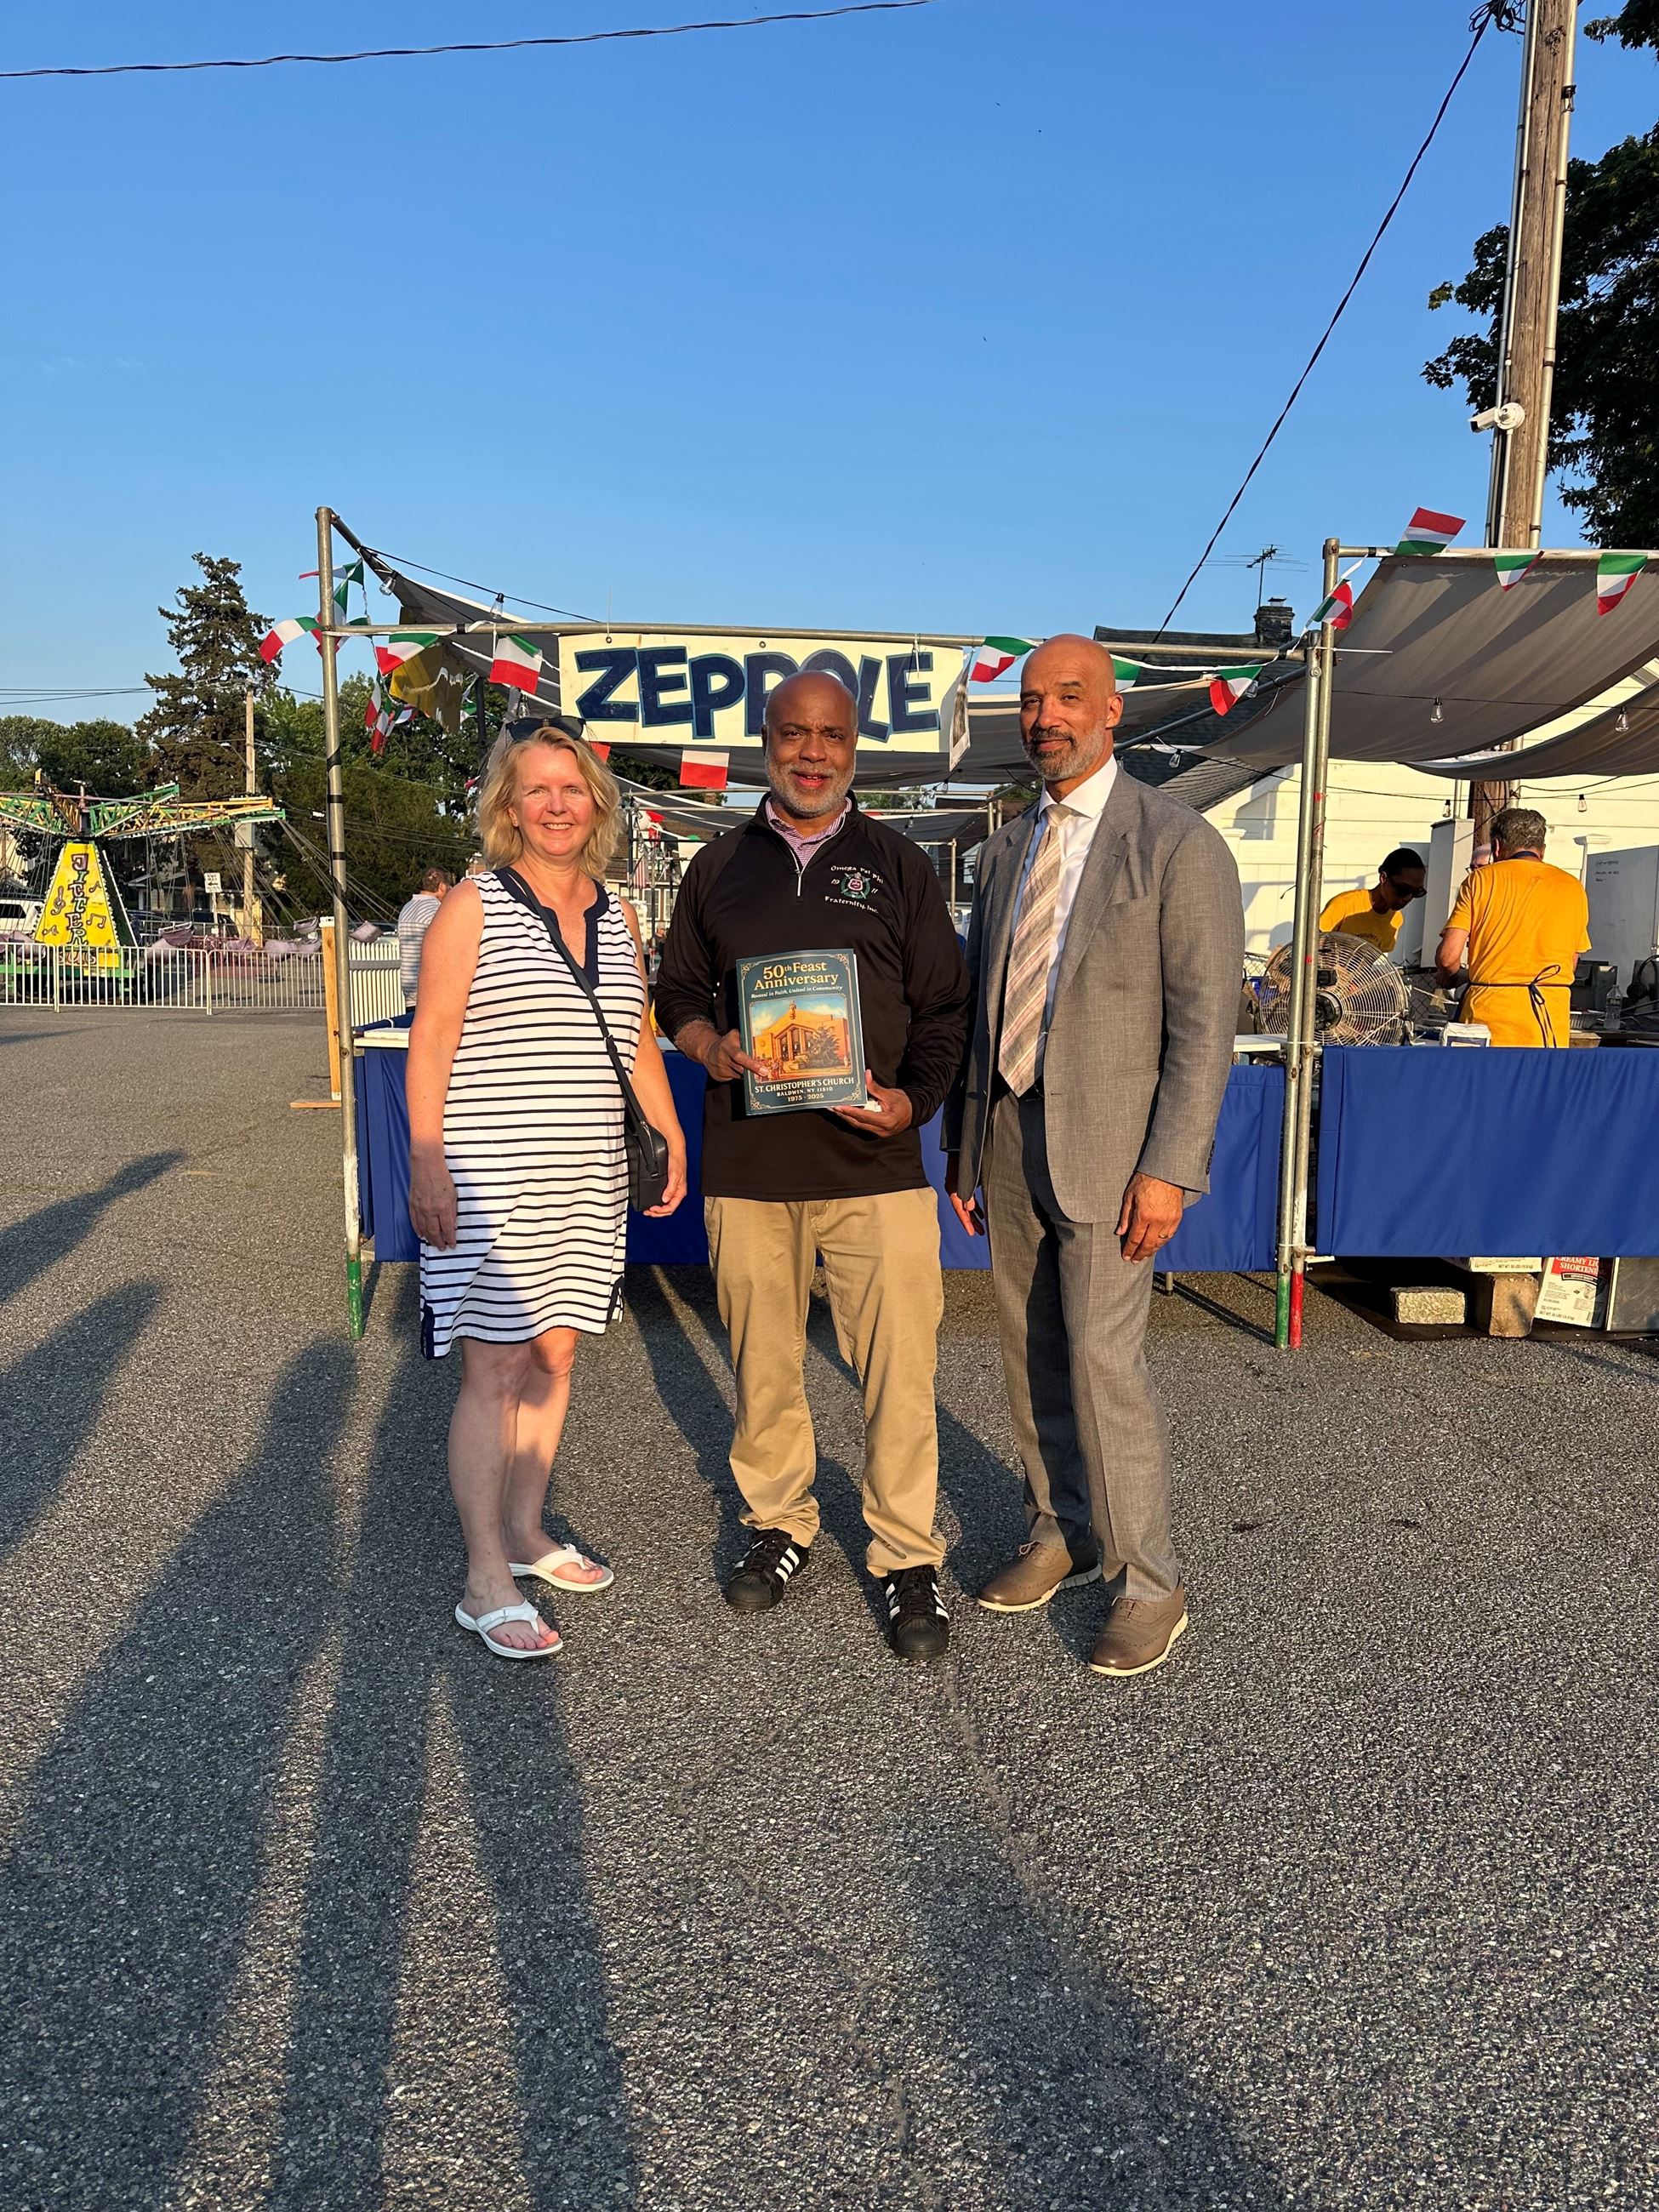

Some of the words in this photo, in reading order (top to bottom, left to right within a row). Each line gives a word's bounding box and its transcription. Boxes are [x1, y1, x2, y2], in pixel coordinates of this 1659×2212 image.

[872, 873, 884, 884] Phi
[65, 853, 88, 945] JITTER
[867, 905, 879, 914] Inc.
[763, 965, 792, 979] 50th
[793, 961, 827, 973] Feast
[754, 974, 839, 990] Anniversary
[766, 1080, 821, 1092] CHRISTOPHER'S
[823, 1077, 854, 1086] CHURCH
